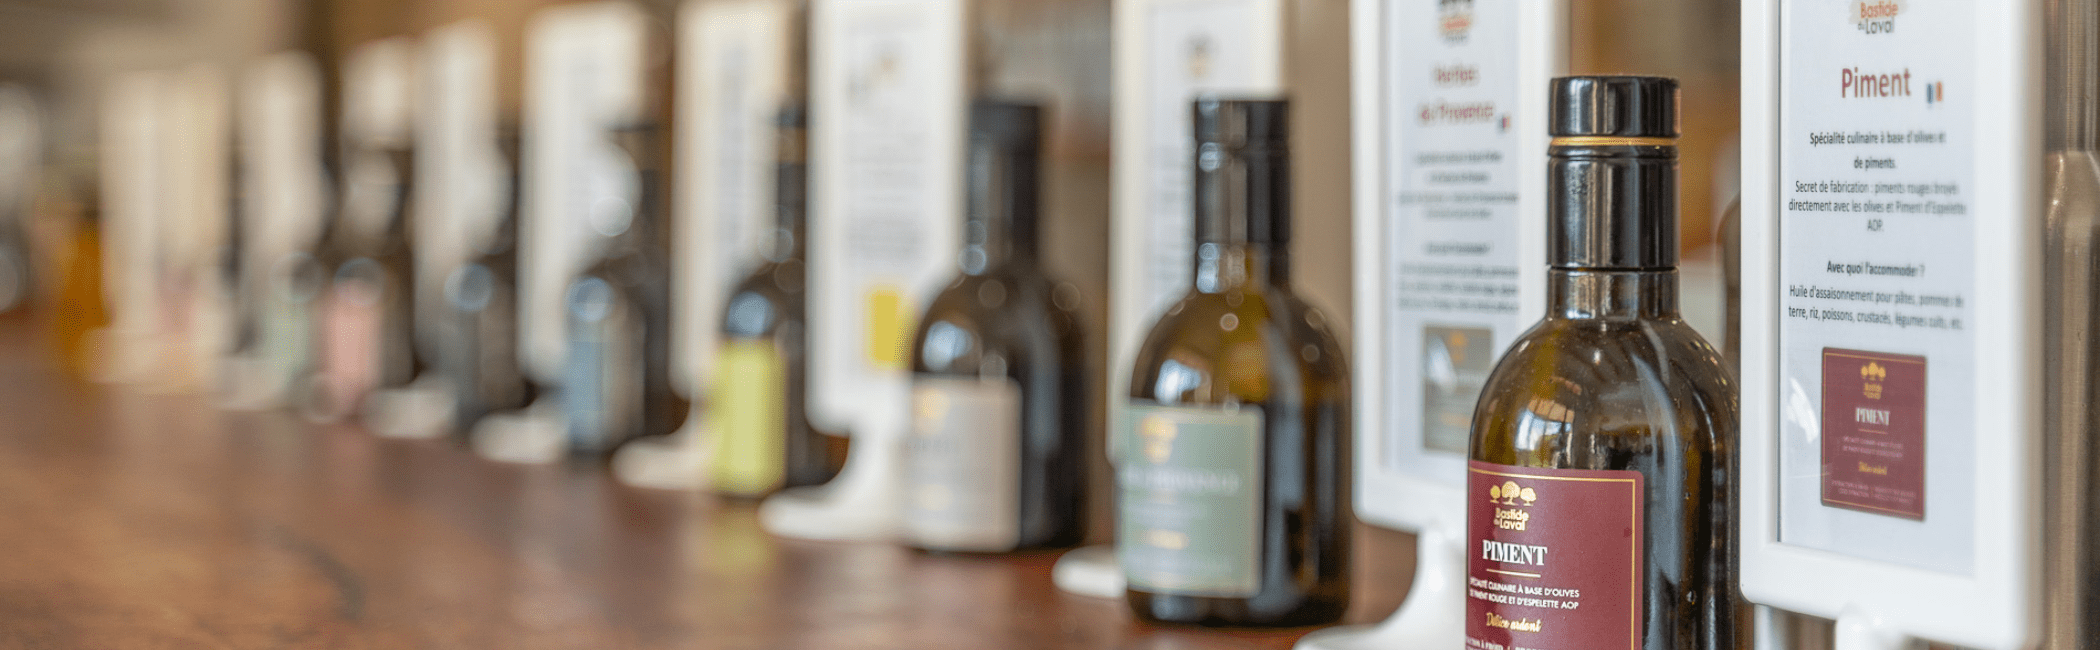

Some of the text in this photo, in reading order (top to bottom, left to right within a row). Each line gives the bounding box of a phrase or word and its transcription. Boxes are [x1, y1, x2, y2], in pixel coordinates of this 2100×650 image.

[1866, 17, 1895, 34] Laval
[1841, 67, 1911, 98] Piment
[1809, 131, 1846, 147] Spécialité
[1847, 130, 1878, 144] culinaire
[1880, 130, 1885, 144] à
[1887, 130, 1904, 144] base
[1854, 156, 1864, 169] de
[1795, 180, 1818, 193] Secret
[1819, 180, 1829, 193] de
[1830, 180, 1869, 193] fabrication
[1875, 182, 1905, 196] piments
[1788, 198, 1832, 212] directement
[1833, 202, 1850, 213] avec
[1852, 200, 1862, 213] les
[1863, 200, 1885, 213] olives
[1886, 203, 1894, 213] et
[1896, 200, 1924, 214] Piment
[1827, 260, 1926, 278] Avec quoi l'accommoder ?
[1789, 285, 1808, 298] Huile
[1809, 285, 1874, 302] d'assaisonnement
[1875, 291, 1893, 306] pour
[1788, 306, 1808, 320] terre,
[1809, 306, 1821, 321] riz,
[1822, 308, 1856, 323] poissons,
[1855, 407, 1891, 427] PIMENT
[1495, 507, 1530, 522] Bastide
[1500, 518, 1526, 531] Laval
[1482, 540, 1548, 566] PIMENT
[1489, 581, 1516, 594] CULINAIRE
[1518, 584, 1524, 594] À
[1525, 586, 1543, 596] BASE
[1544, 588, 1580, 598] D'OLIVES
[1489, 593, 1508, 604] ROUGE
[1508, 596, 1516, 605] ET
[1517, 596, 1559, 609] D'ESPELETTE
[1560, 601, 1580, 610] AOP
